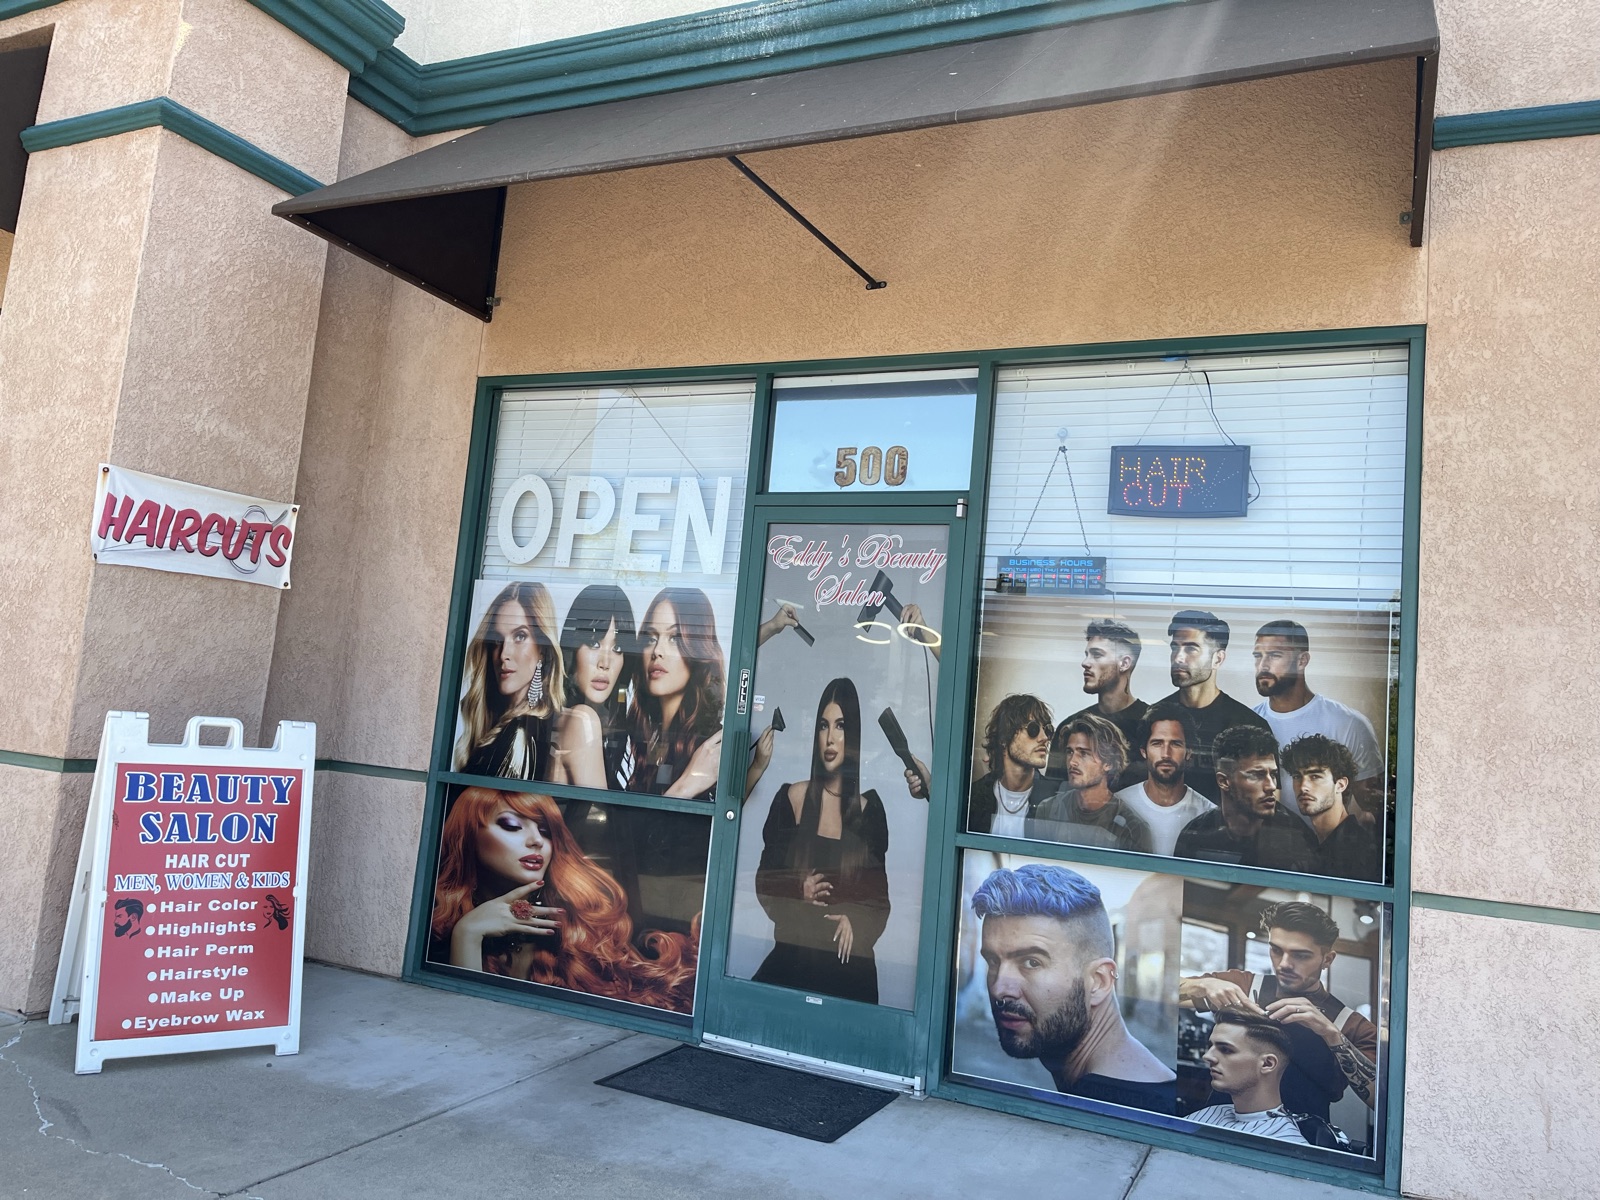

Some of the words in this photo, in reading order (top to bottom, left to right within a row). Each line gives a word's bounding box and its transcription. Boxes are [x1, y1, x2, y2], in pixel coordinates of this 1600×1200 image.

[834, 446, 908, 488] 500
[1119, 456, 1207, 483] HAIR
[1122, 482, 1191, 508] CUT
[97, 491, 293, 567] HAIRCUTS
[498, 474, 732, 575] OPEN
[855, 533, 947, 584] Beauty
[1060, 559, 1094, 567] HOURS
[814, 572, 887, 612] Salon
[740, 673, 748, 702] PULL
[123, 771, 296, 805] BEAUTY
[139, 811, 278, 844] SALON
[165, 854, 209, 869] HAIR
[215, 853, 250, 868] CUT
[114, 873, 161, 894] MEN,
[164, 873, 233, 891] WOMEN
[235, 873, 250, 889] &
[251, 872, 291, 888] KIDS
[160, 901, 202, 913] Hair
[208, 899, 258, 911] Color
[158, 921, 257, 938] Highlights
[157, 945, 199, 958] Hair
[205, 944, 254, 956] Perm
[159, 965, 249, 981] Hairstyle
[160, 990, 212, 1004] Make
[219, 988, 245, 1001] Up
[134, 1012, 219, 1031] Eyebrow
[226, 1009, 265, 1021] Wax
